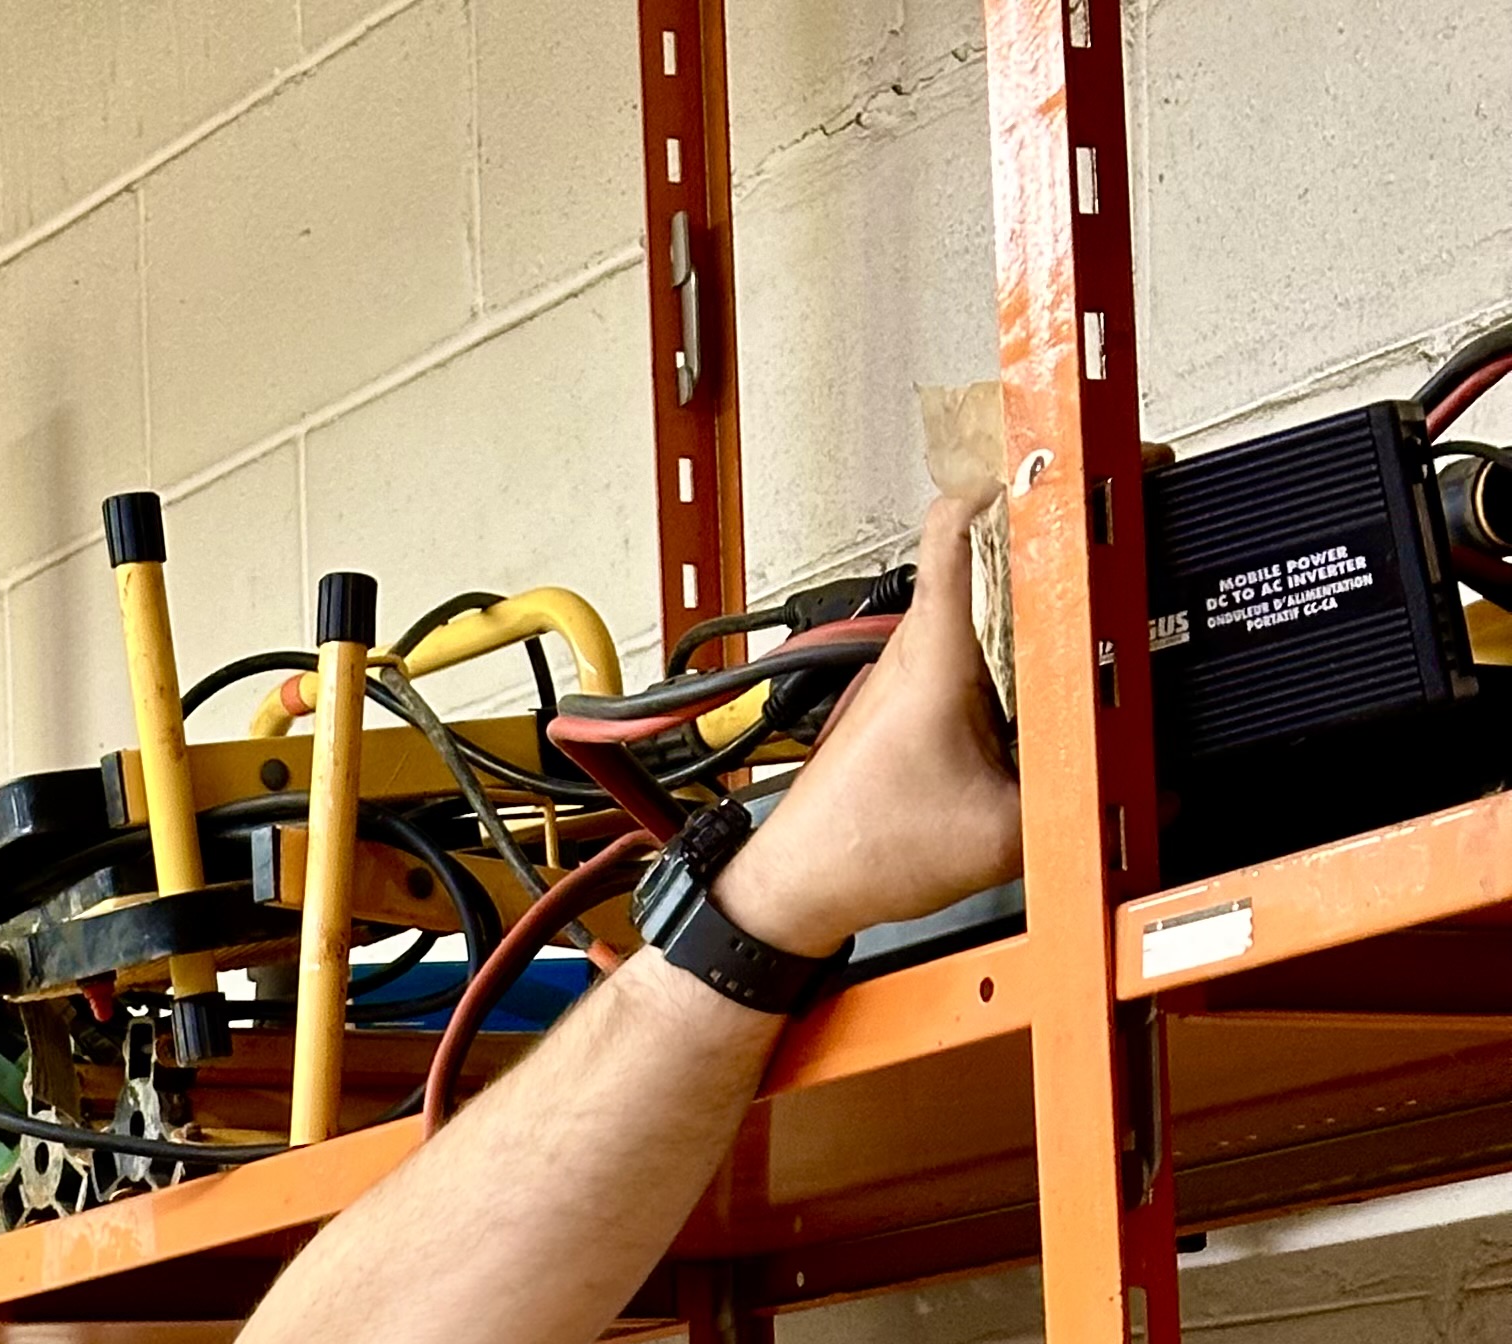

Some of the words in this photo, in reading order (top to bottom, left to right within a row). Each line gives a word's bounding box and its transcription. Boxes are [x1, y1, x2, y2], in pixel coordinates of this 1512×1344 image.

[1205, 595, 1228, 611] DC
[1232, 587, 1255, 604] TO
[1261, 578, 1283, 597] AC
[1288, 556, 1367, 589] INVERTER
[1218, 564, 1282, 592] MOBILE
[1287, 545, 1348, 574] POWER
[1207, 602, 1269, 629] ONDULEUR
[1273, 572, 1373, 611] D'ALIMENTATION
[1247, 608, 1299, 631] PORTATIF
[1303, 597, 1338, 617] CC-CA
